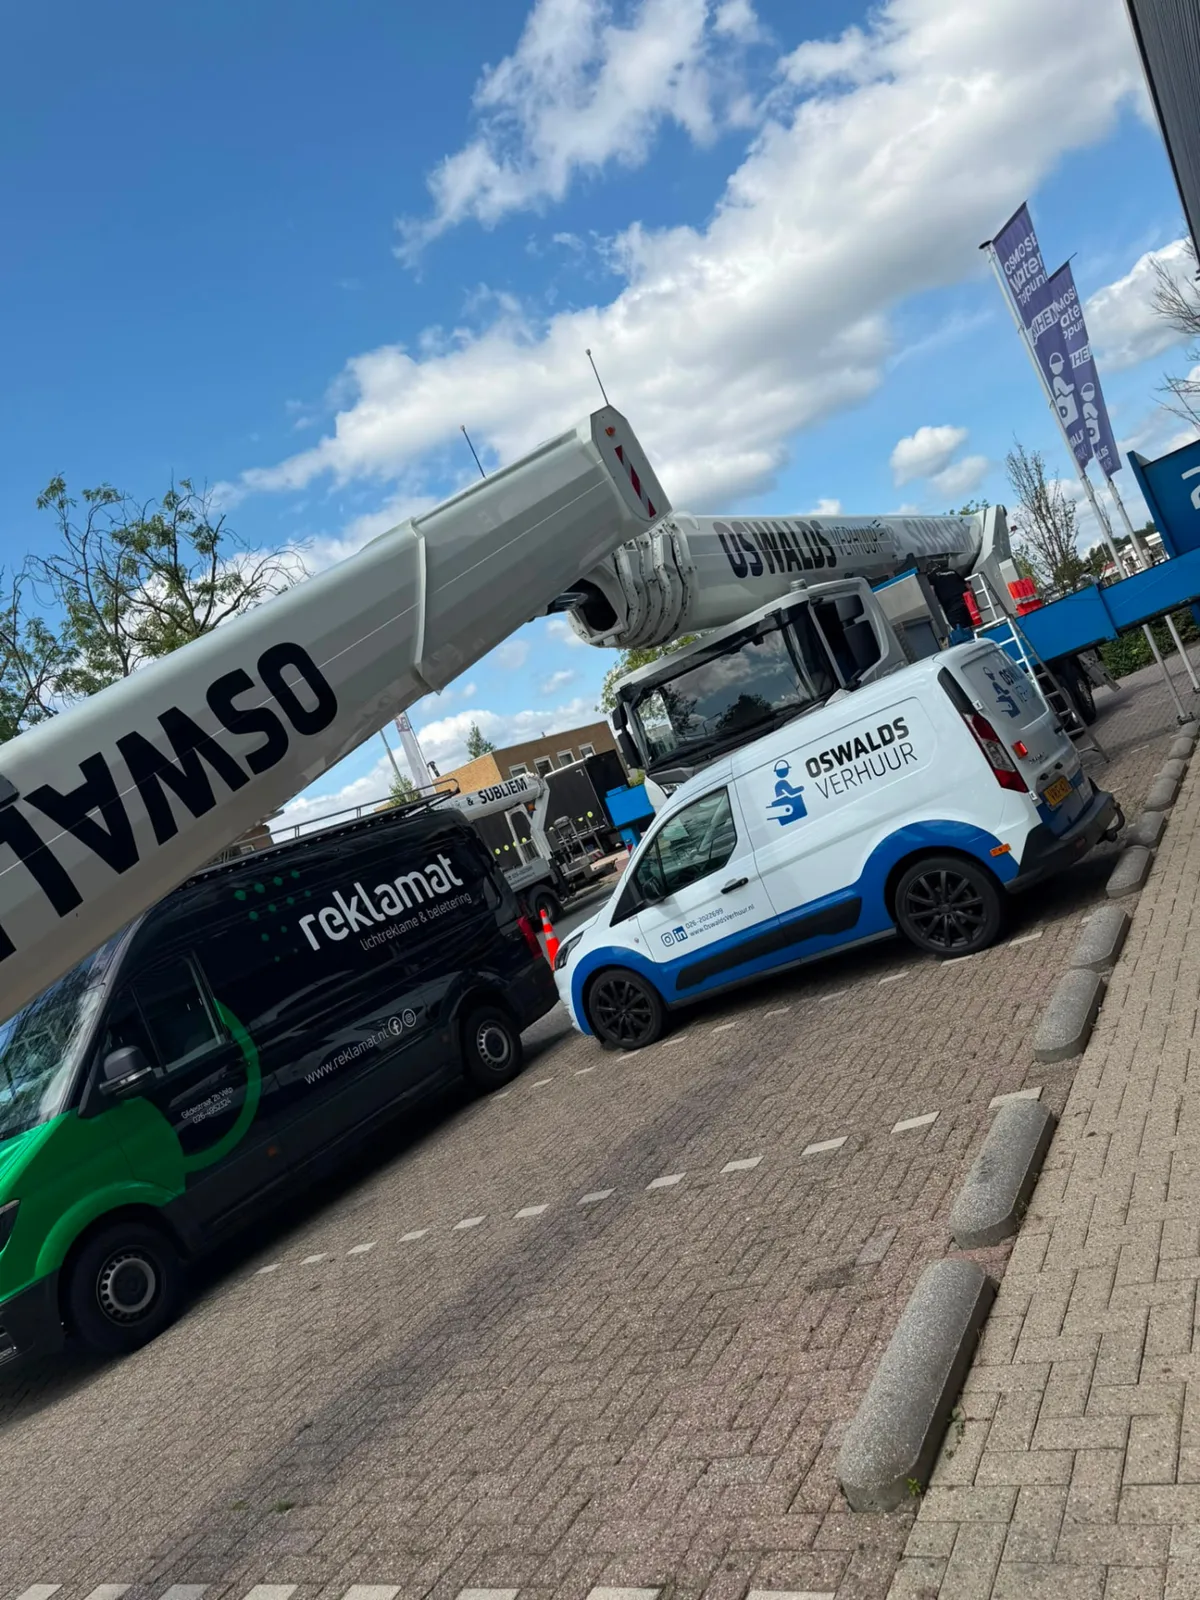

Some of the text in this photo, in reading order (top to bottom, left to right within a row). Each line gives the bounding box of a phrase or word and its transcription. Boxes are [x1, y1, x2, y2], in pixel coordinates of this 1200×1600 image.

[712, 519, 837, 578] OSWALDS
[805, 716, 910, 779] OSWALDS
[815, 742, 918, 799] VERHUUR
[0, 641, 338, 963] OSWAL
[466, 796, 474, 807] &
[478, 777, 528, 804] SUBLIEM
[298, 853, 464, 951] reklamat
[359, 891, 472, 951] lichtreklame & belettering
[685, 907, 724, 929] 026-2022699
[304, 1027, 389, 1085] www.reklamat.nl
